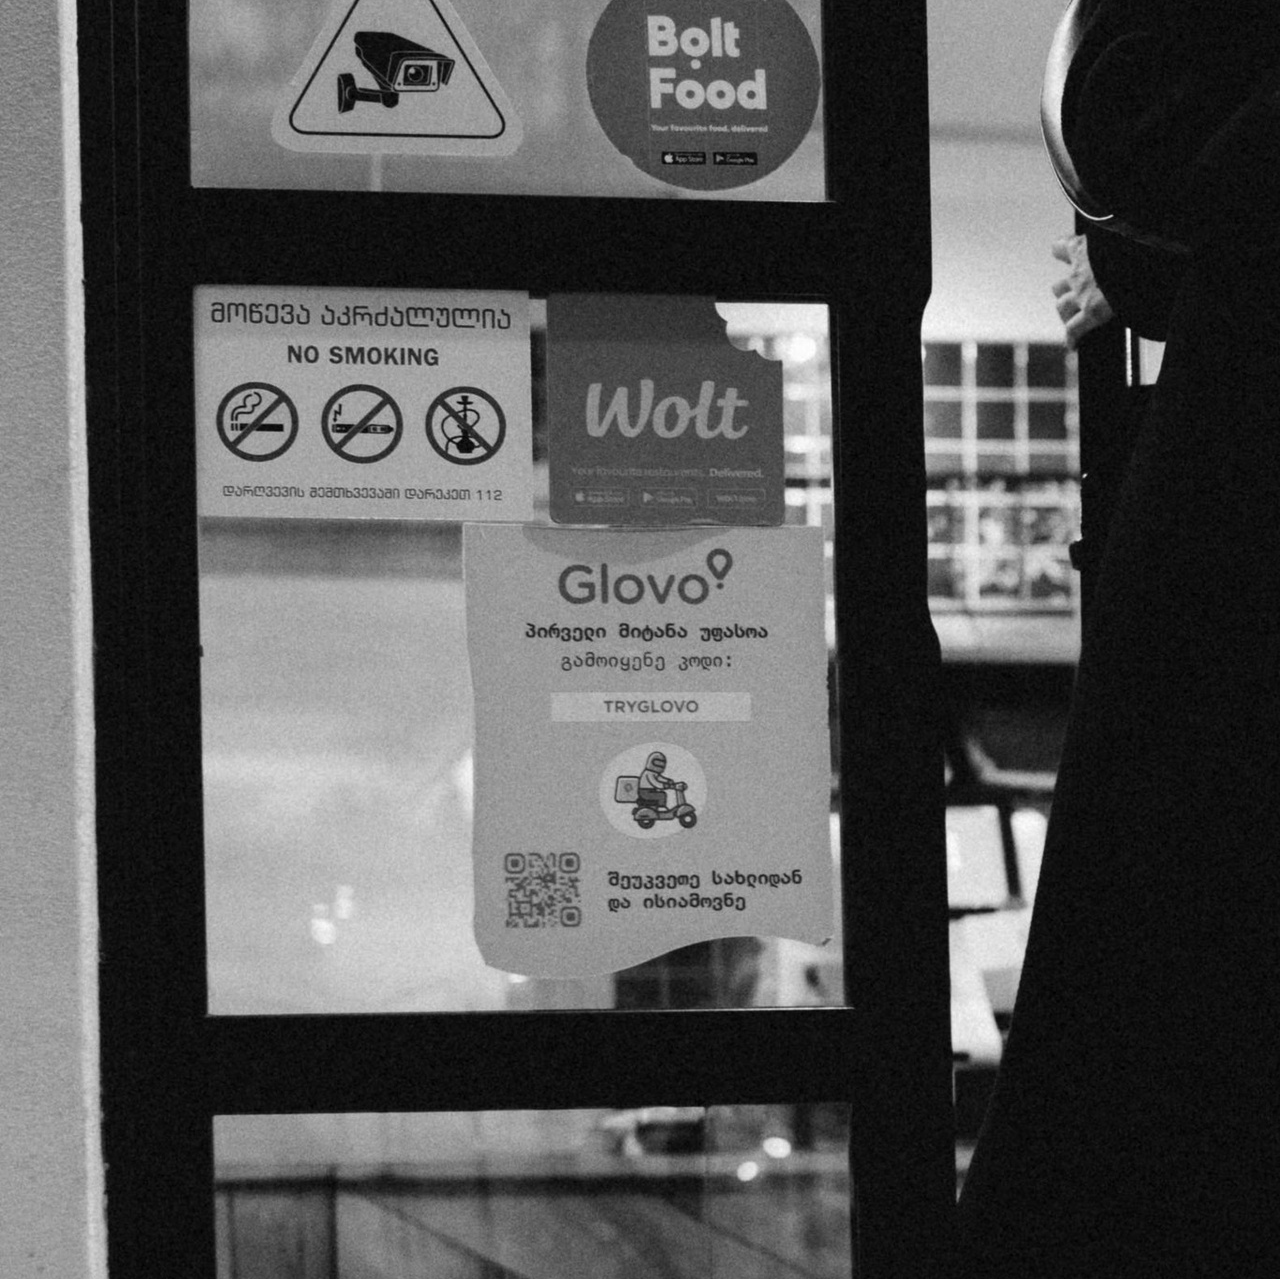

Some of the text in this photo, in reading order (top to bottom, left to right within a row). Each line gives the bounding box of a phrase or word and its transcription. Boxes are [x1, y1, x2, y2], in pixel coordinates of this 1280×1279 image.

[648, 16, 740, 69] Bolt
[650, 68, 766, 109] Food
[288, 346, 438, 366] NO SMOKING
[586, 379, 748, 439] Wolt
[477, 490, 502, 501] 112
[559, 563, 709, 604] Glovo
[525, 623, 768, 642] პირველი მიტანა უფასოა
[561, 651, 731, 671] გამოიყენე კოდი:
[604, 700, 698, 713] TRYGLOVO
[608, 869, 802, 890] შეუკვეთე სახლიდან
[608, 892, 746, 913] და ისიამოვნე
